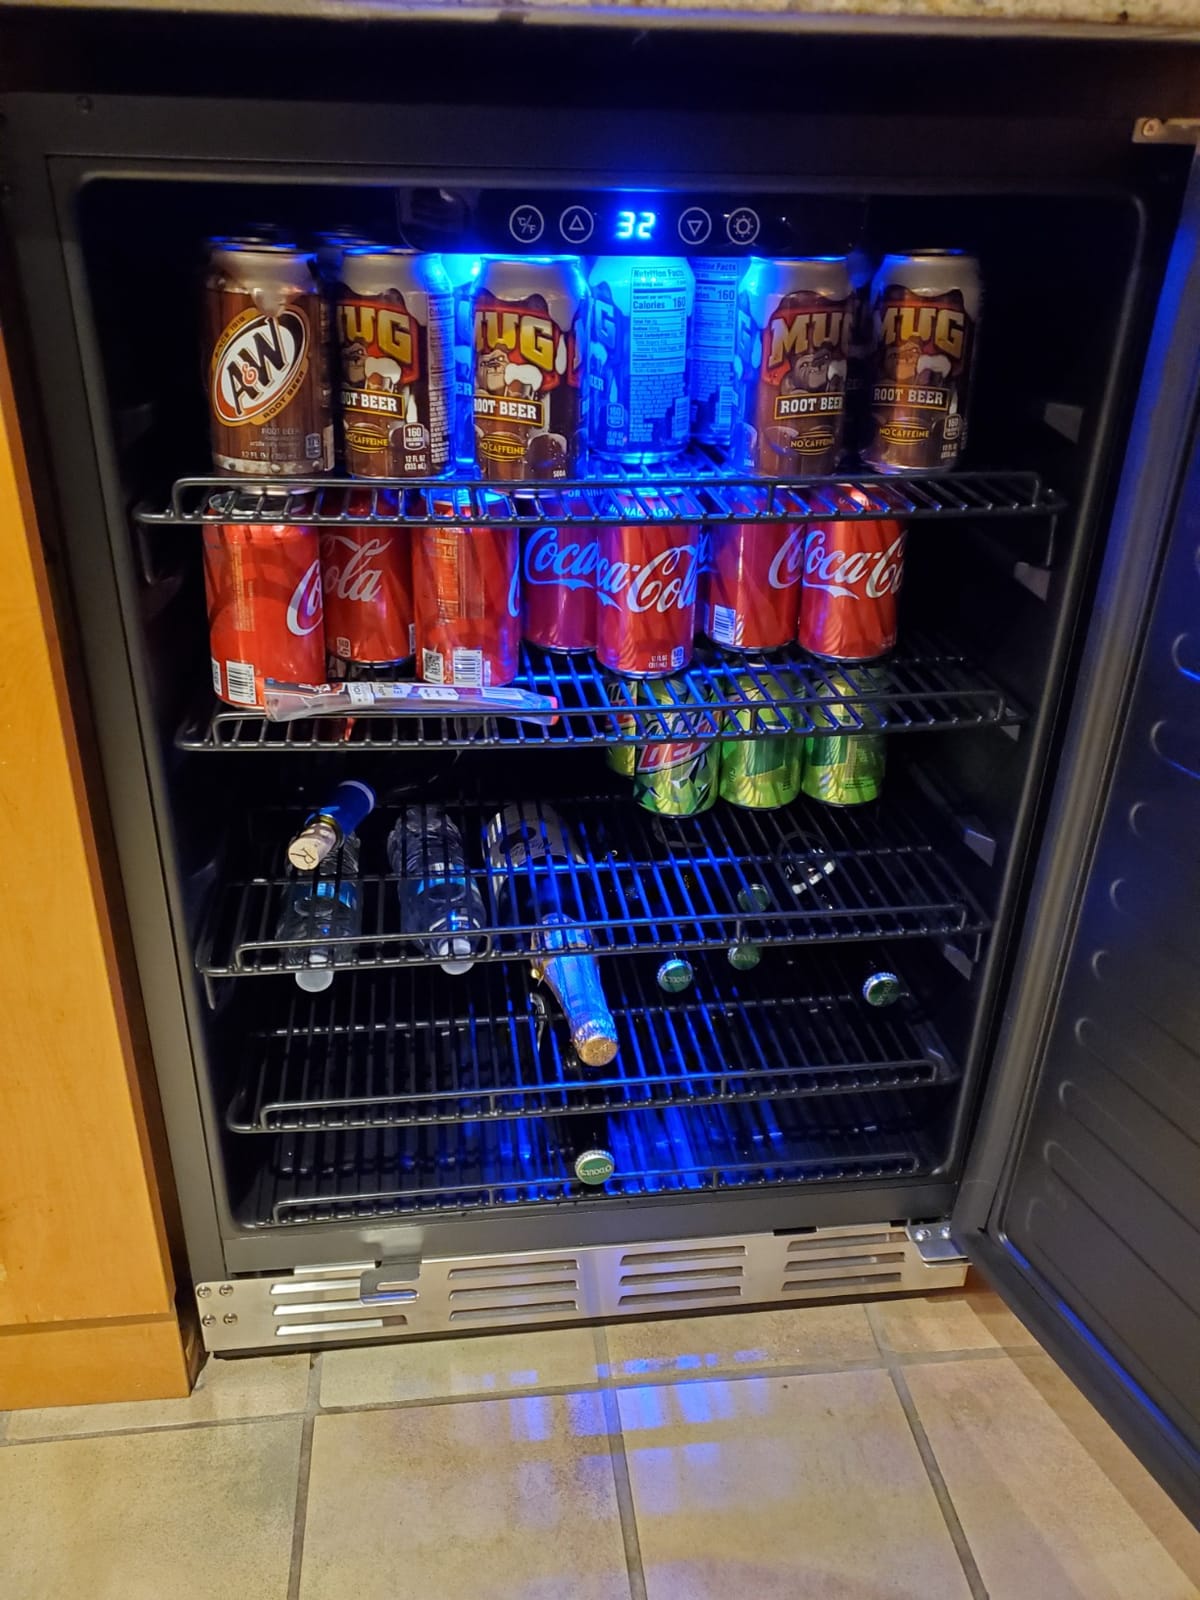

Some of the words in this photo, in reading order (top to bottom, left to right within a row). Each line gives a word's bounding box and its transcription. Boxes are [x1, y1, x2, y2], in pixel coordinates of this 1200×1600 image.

[616, 211, 656, 238] 32
[719, 290, 735, 300] 160
[633, 301, 665, 309] Calories
[337, 305, 411, 364] UG
[769, 312, 853, 368] MU
[227, 317, 288, 416] A&W
[361, 393, 398, 412] BEER
[874, 388, 903, 401] ROOT
[908, 389, 943, 405] BEER
[263, 397, 287, 419] ROOT
[474, 399, 496, 414] OOT
[500, 401, 537, 420] BEER
[780, 398, 817, 414] ROOT
[354, 434, 388, 446] CAFFEINE
[407, 427, 421, 437] 160
[892, 428, 929, 438] CAFFEINE
[489, 443, 525, 455] CAFFEINE
[791, 440, 803, 448] NO
